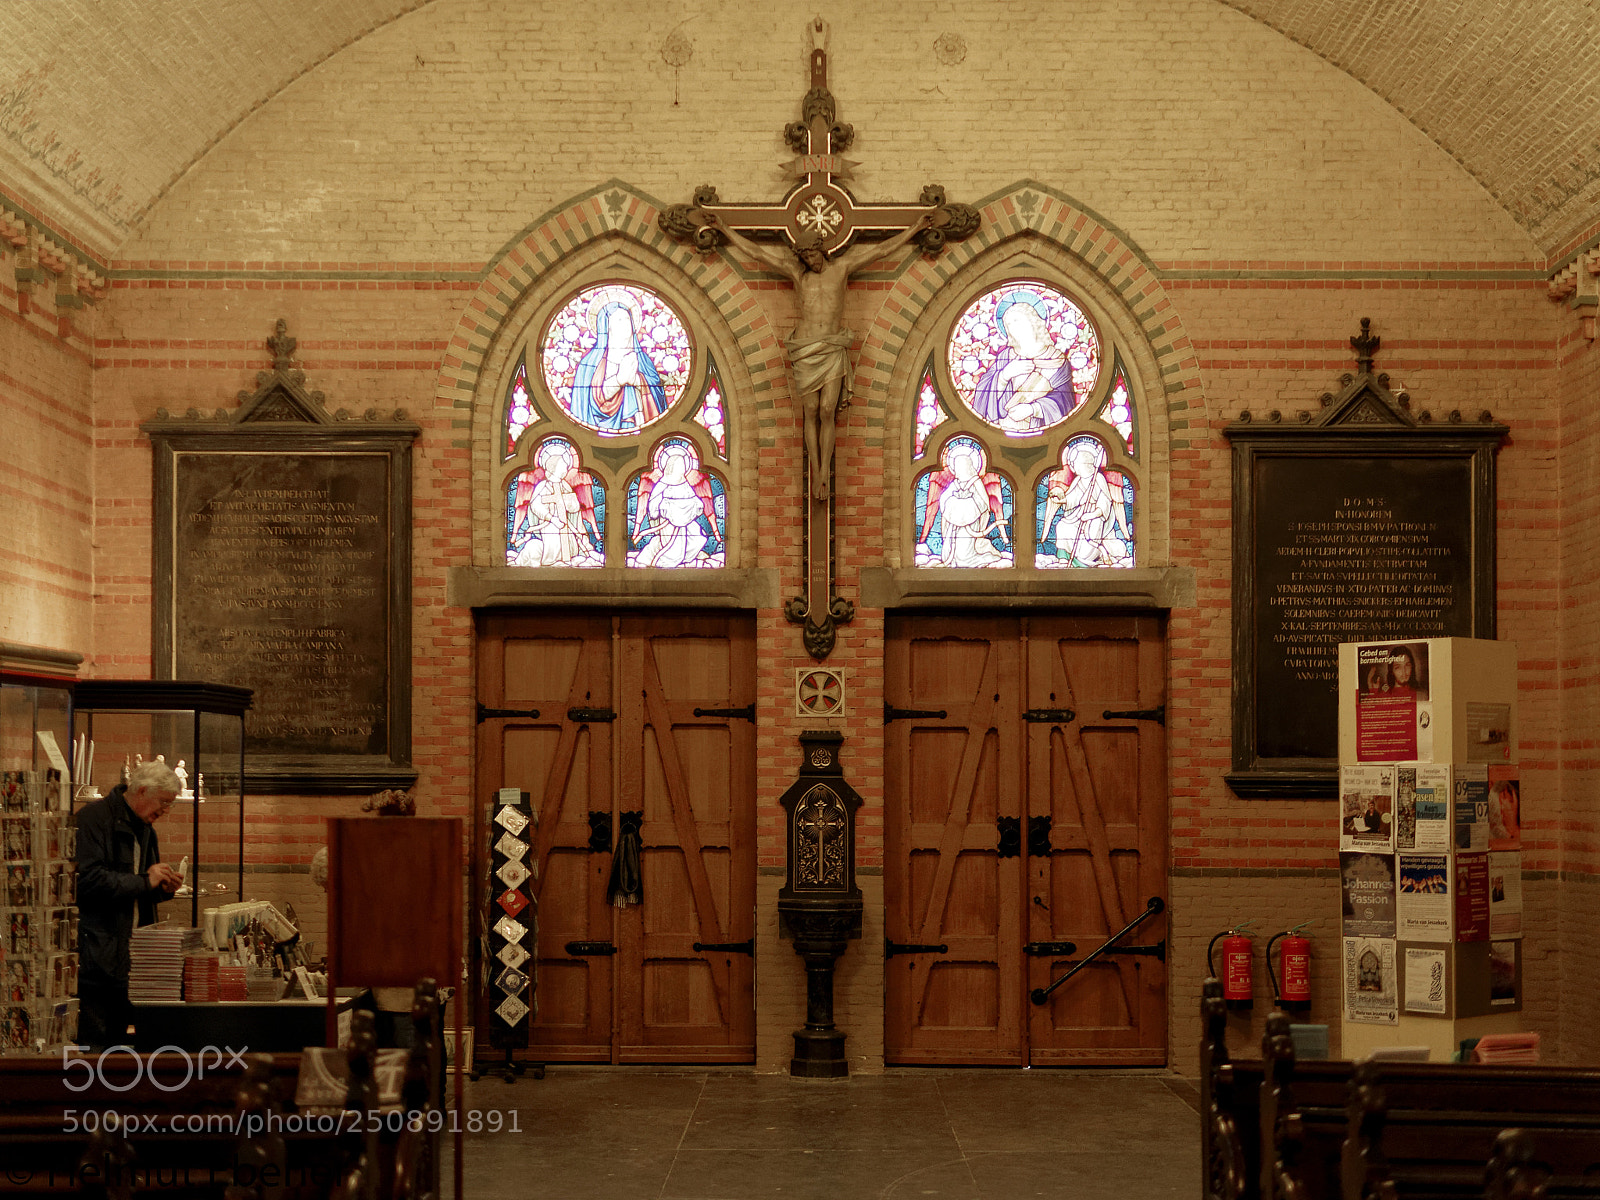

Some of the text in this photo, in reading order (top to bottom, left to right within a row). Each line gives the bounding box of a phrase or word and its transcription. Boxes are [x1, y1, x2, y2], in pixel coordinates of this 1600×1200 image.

[1360, 649, 1378, 657] Gebed
[1411, 792, 1434, 802] Pasen
[1343, 877, 1394, 889] Johannes
[1350, 893, 1388, 904] Passion
